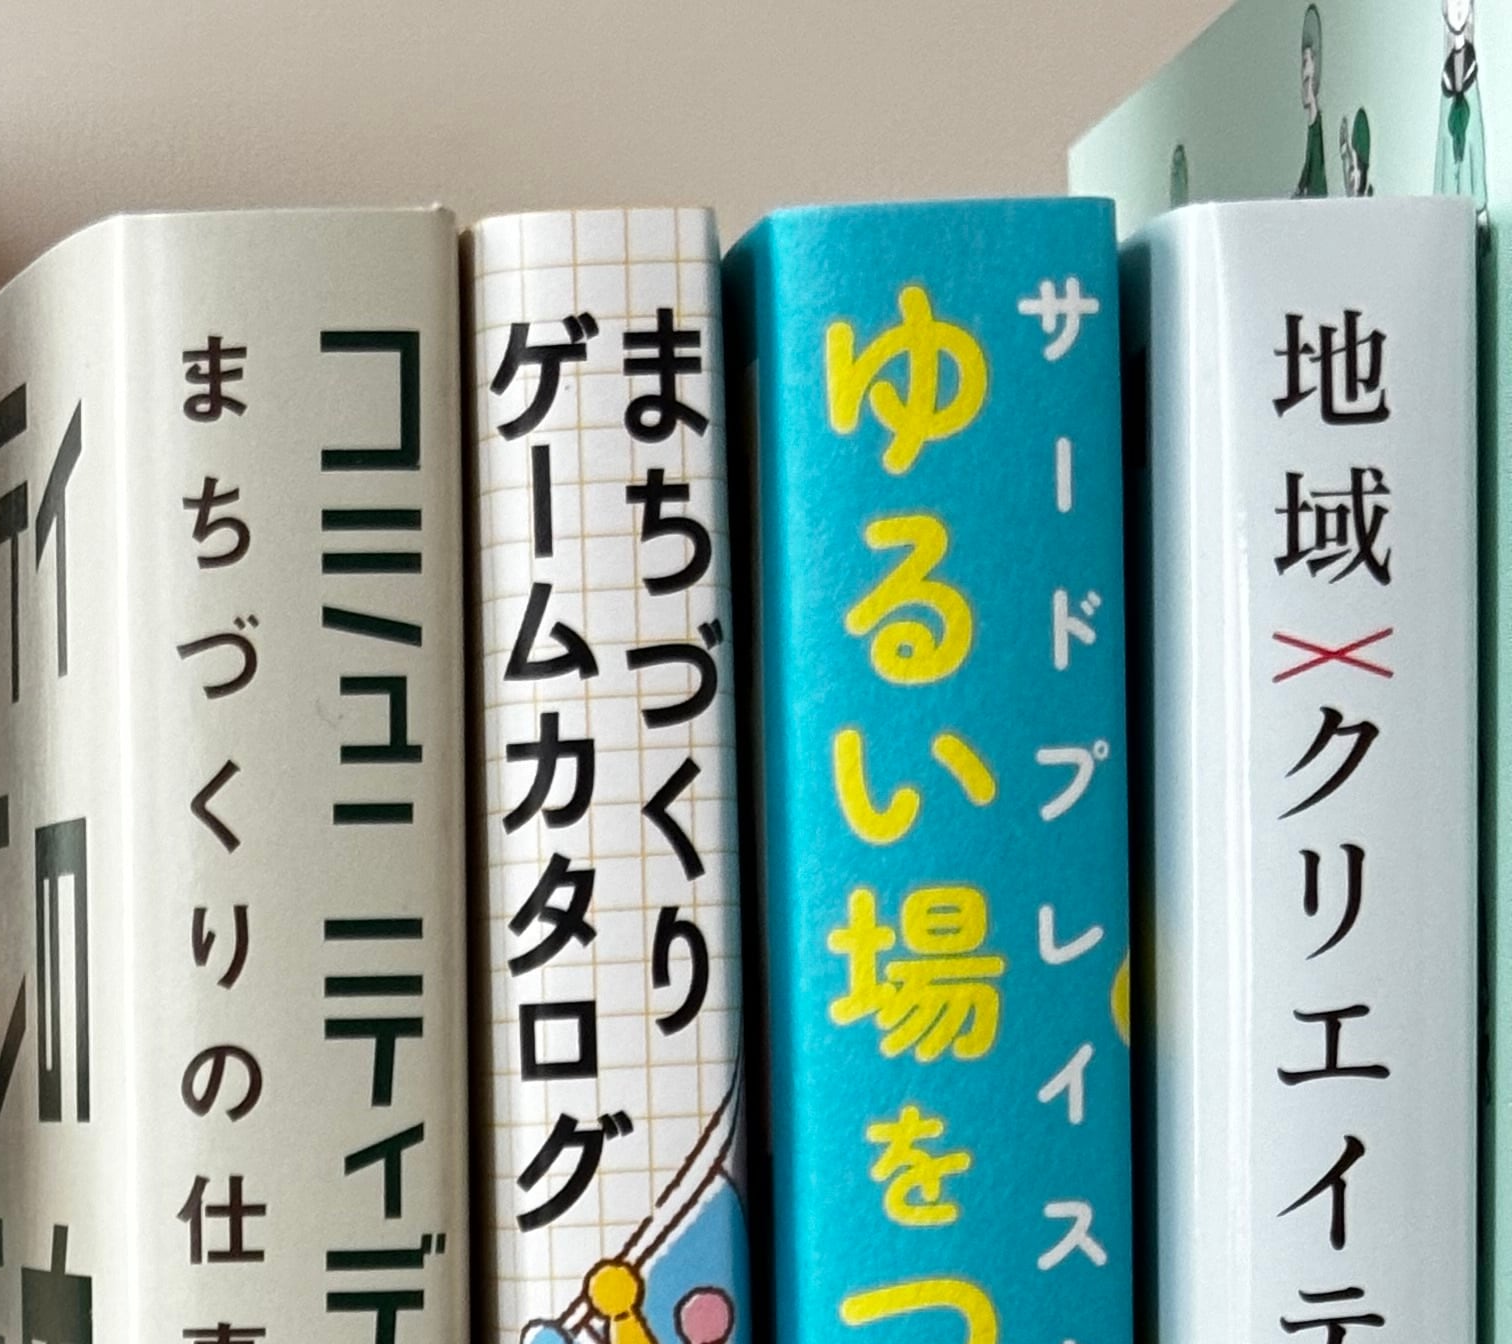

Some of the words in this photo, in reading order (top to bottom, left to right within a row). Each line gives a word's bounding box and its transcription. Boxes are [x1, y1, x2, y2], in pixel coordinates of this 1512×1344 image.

[489, 312, 633, 1232] ゲームカタログ
[622, 307, 723, 1036] まちづくり
